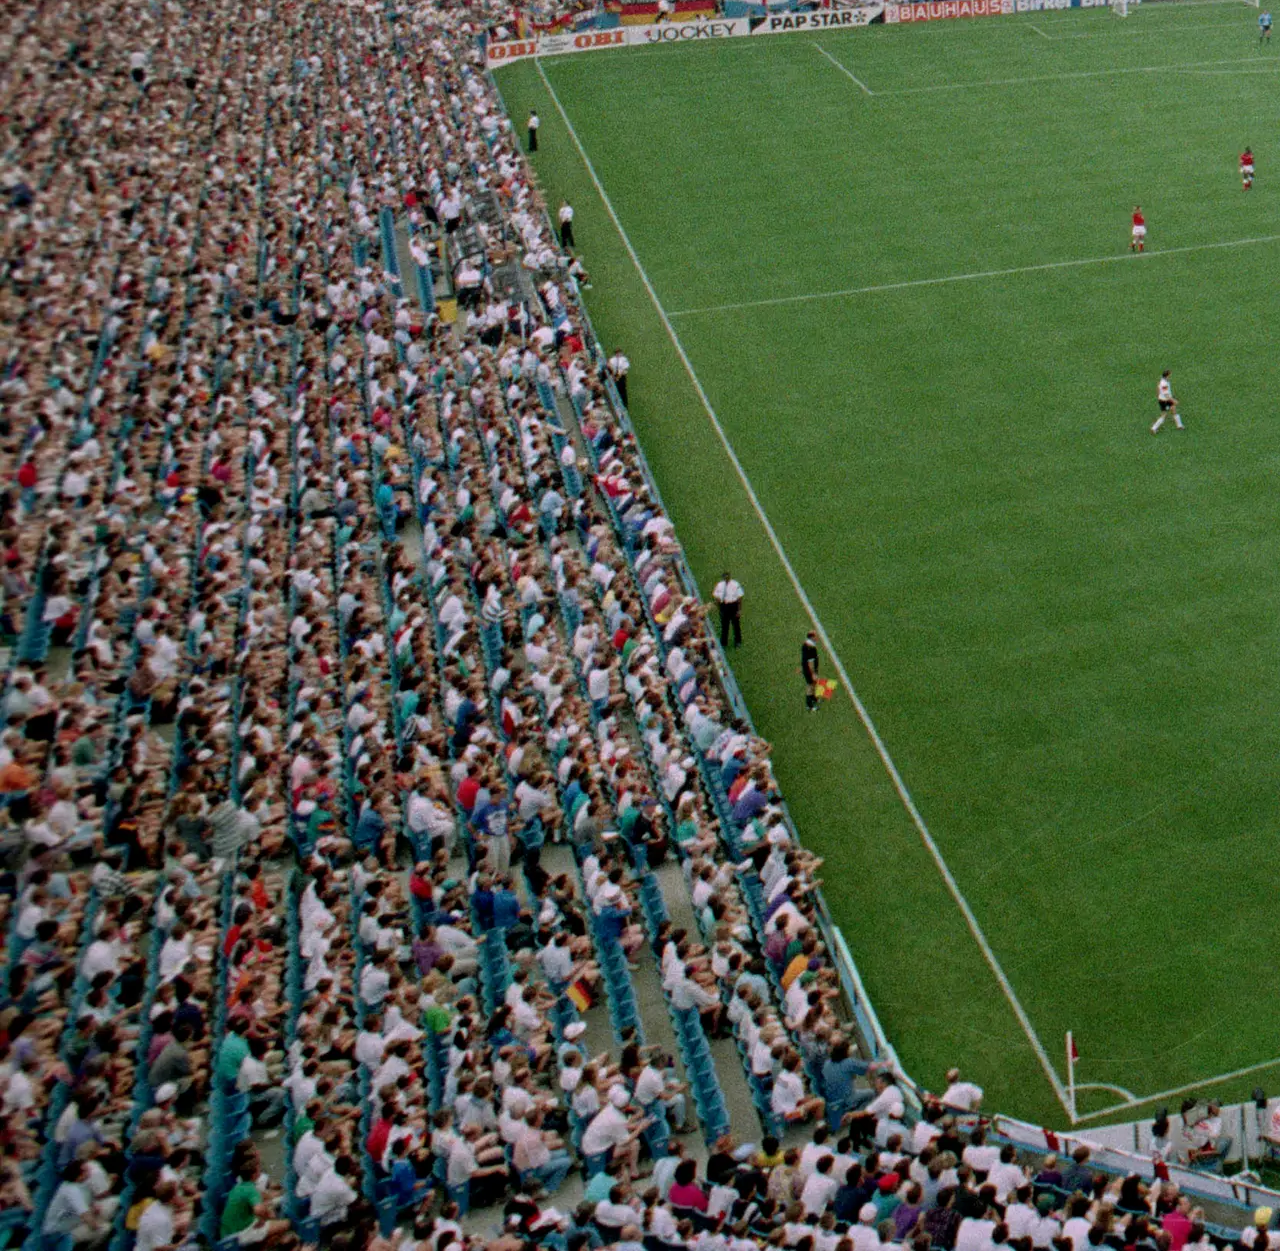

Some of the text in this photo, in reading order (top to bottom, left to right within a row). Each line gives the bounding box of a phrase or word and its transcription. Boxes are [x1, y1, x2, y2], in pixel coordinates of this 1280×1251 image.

[771, 11, 853, 30] PAP STAR
[900, 0, 1001, 20] BAUHAUS
[649, 22, 737, 44] JOCKEY
[488, 41, 537, 60] OBI
[574, 30, 625, 49] OBI
